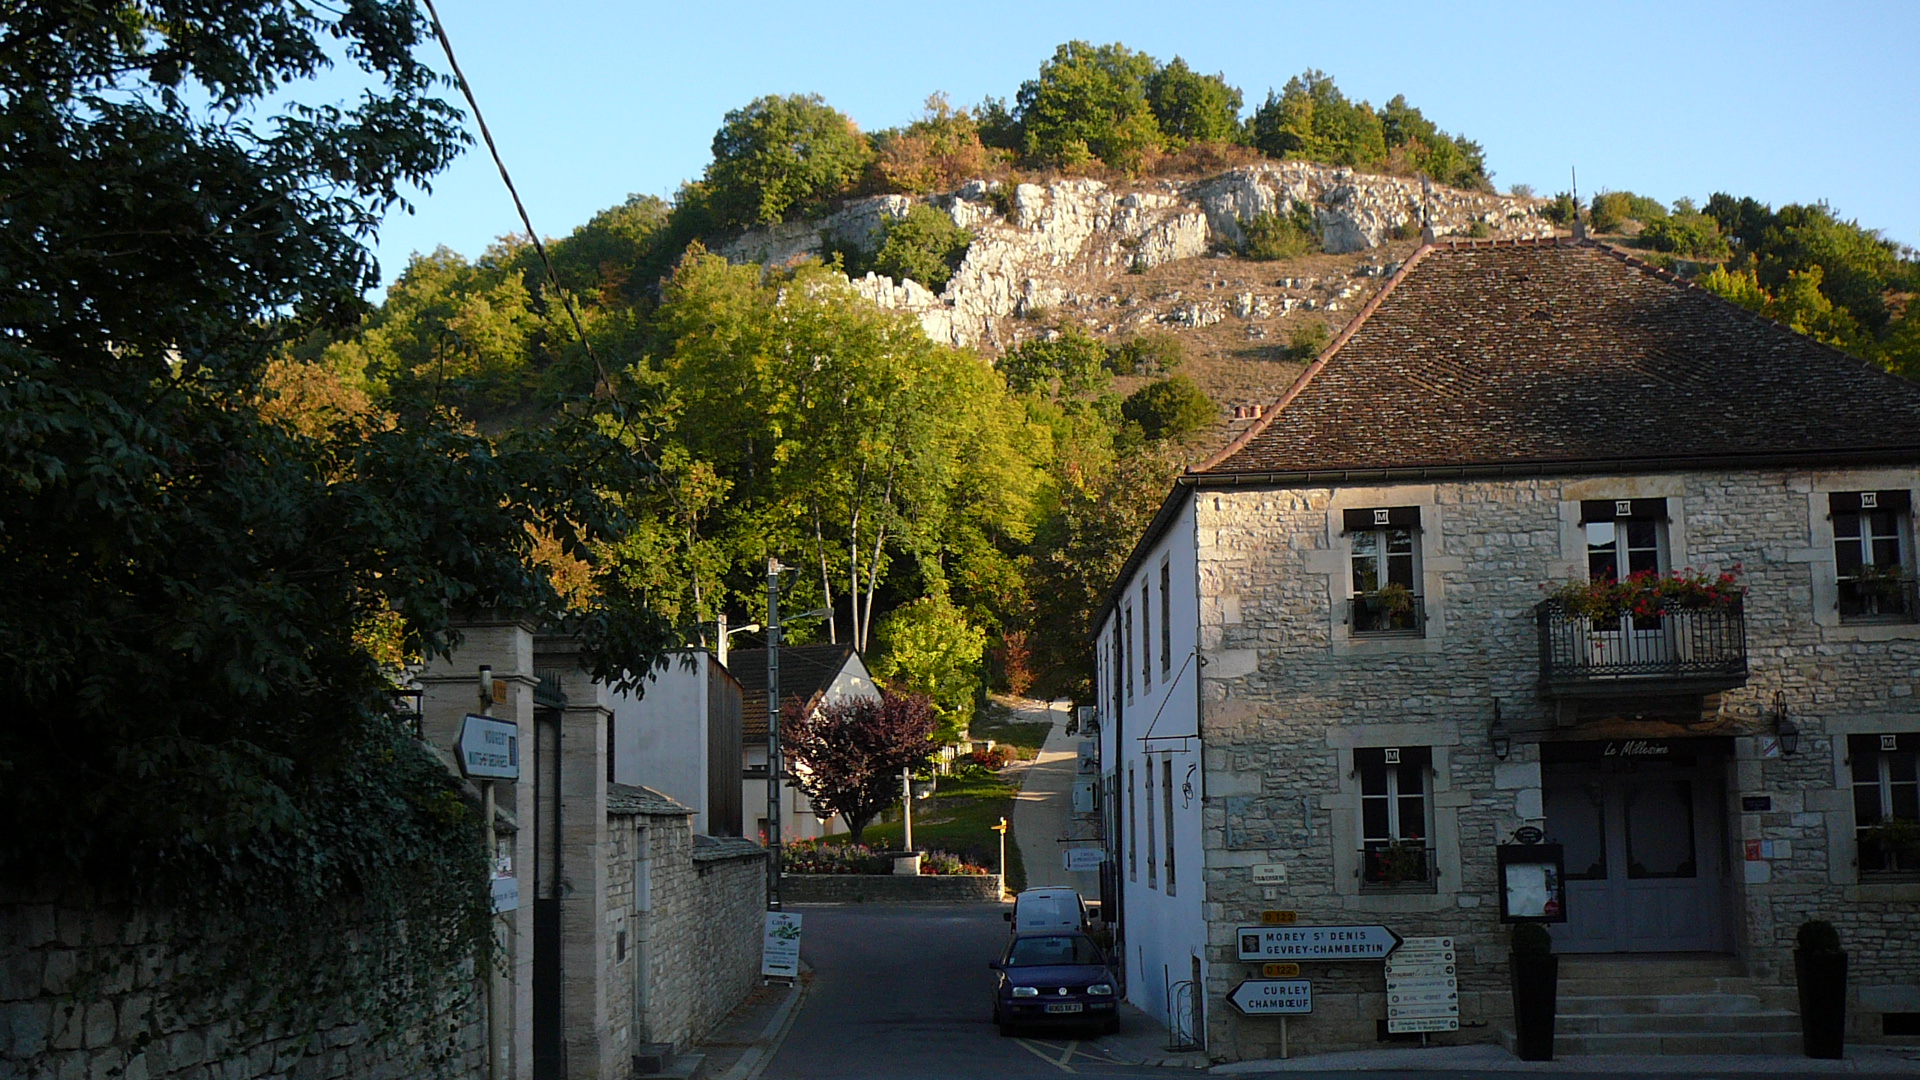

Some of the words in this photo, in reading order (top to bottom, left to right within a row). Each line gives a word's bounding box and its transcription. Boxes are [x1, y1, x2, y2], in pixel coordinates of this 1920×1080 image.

[1603, 742, 1616, 756] Le
[1265, 913, 1271, 921] D
[1277, 913, 1294, 922] 122
[1266, 932, 1306, 941] MOREY
[1330, 931, 1367, 941] DENIS
[1266, 944, 1383, 954] GEVREY-CHAMBERTIN
[1263, 986, 1308, 995] CURLEY
[1248, 999, 1309, 1008] CHAMBŒUF
